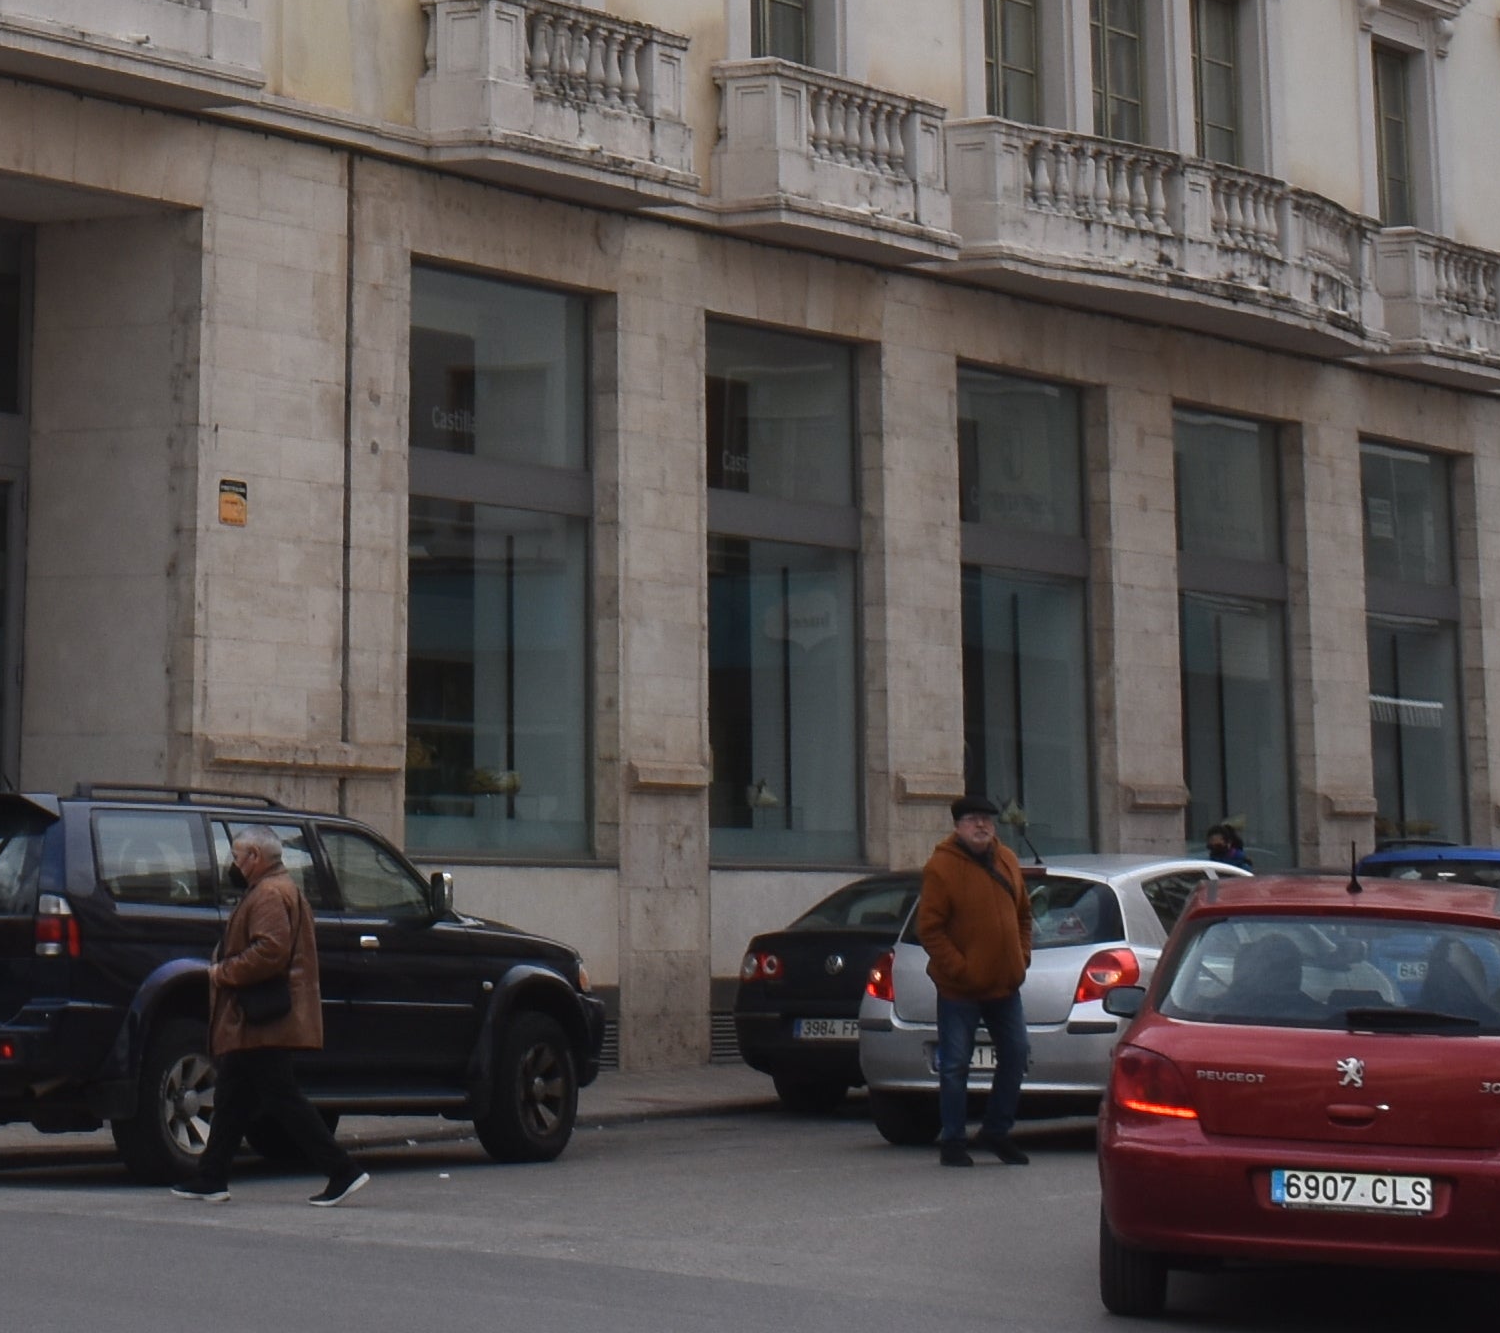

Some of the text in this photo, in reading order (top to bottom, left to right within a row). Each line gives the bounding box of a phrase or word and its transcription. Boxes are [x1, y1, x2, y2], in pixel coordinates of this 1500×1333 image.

[1196, 1069, 1266, 1083] PEUGEOT
[1286, 1174, 1426, 1206] 6907 CLS
